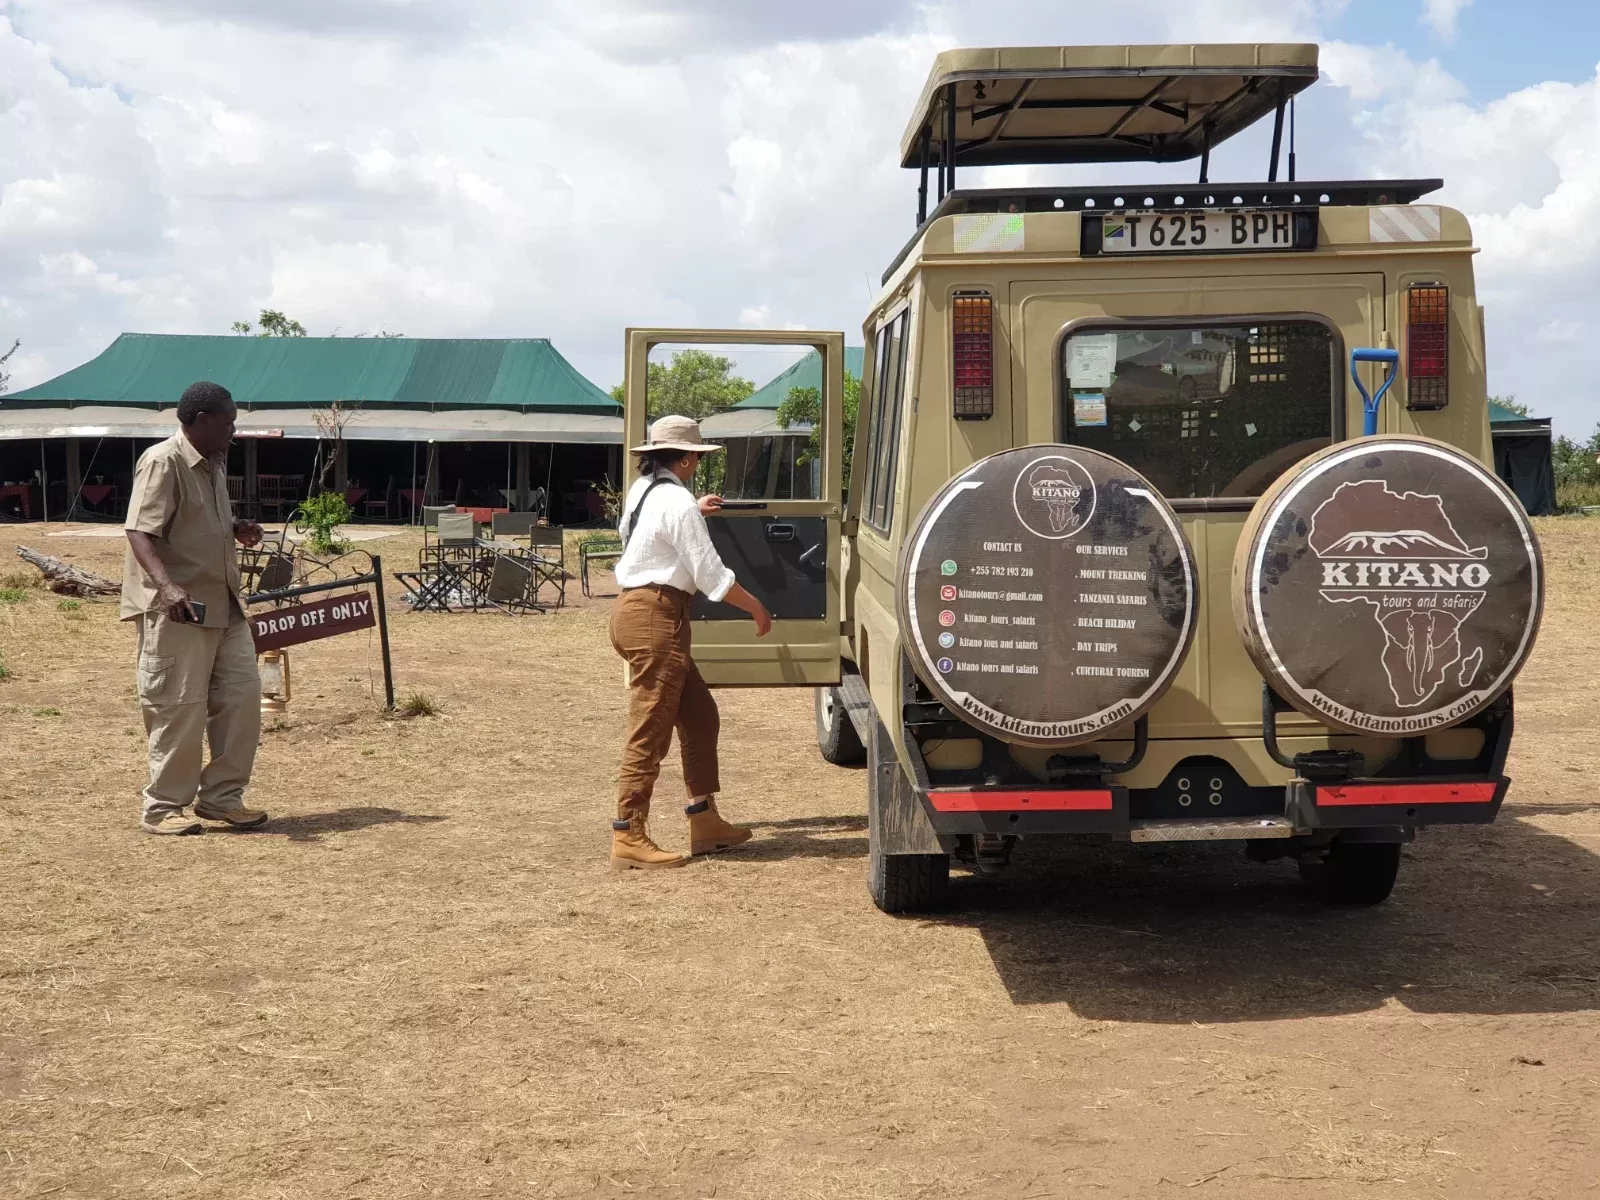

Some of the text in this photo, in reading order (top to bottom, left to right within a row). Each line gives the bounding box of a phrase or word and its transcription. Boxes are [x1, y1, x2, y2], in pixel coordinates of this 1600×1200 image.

[1124, 214, 1289, 247] T 625 BPH
[1032, 487, 1080, 498] KITANO
[983, 541, 1022, 552] CONTACT US
[1076, 544, 1128, 556] OUR SERVICES
[970, 566, 1034, 577] +255 782 193 210
[1080, 569, 1147, 581] MOUNT TREKKING
[1321, 562, 1492, 588] KITANO
[1079, 593, 1147, 606] TANZANIA SAFARIS
[1383, 593, 1478, 609] tours and safaris
[256, 600, 369, 637] DROP OFF ONLY
[1078, 617, 1103, 628] BEACH
[959, 637, 983, 648] kitano
[1000, 640, 1014, 649] and
[1015, 640, 1038, 650] safaris
[1077, 641, 1118, 653] DAY TRIPS
[956, 661, 1039, 675] kitano tours and safaris
[1116, 667, 1150, 678] TOURISM
[962, 696, 1134, 737] www.kitanotours.com
[1311, 693, 1481, 731] www.kitanotours.com
